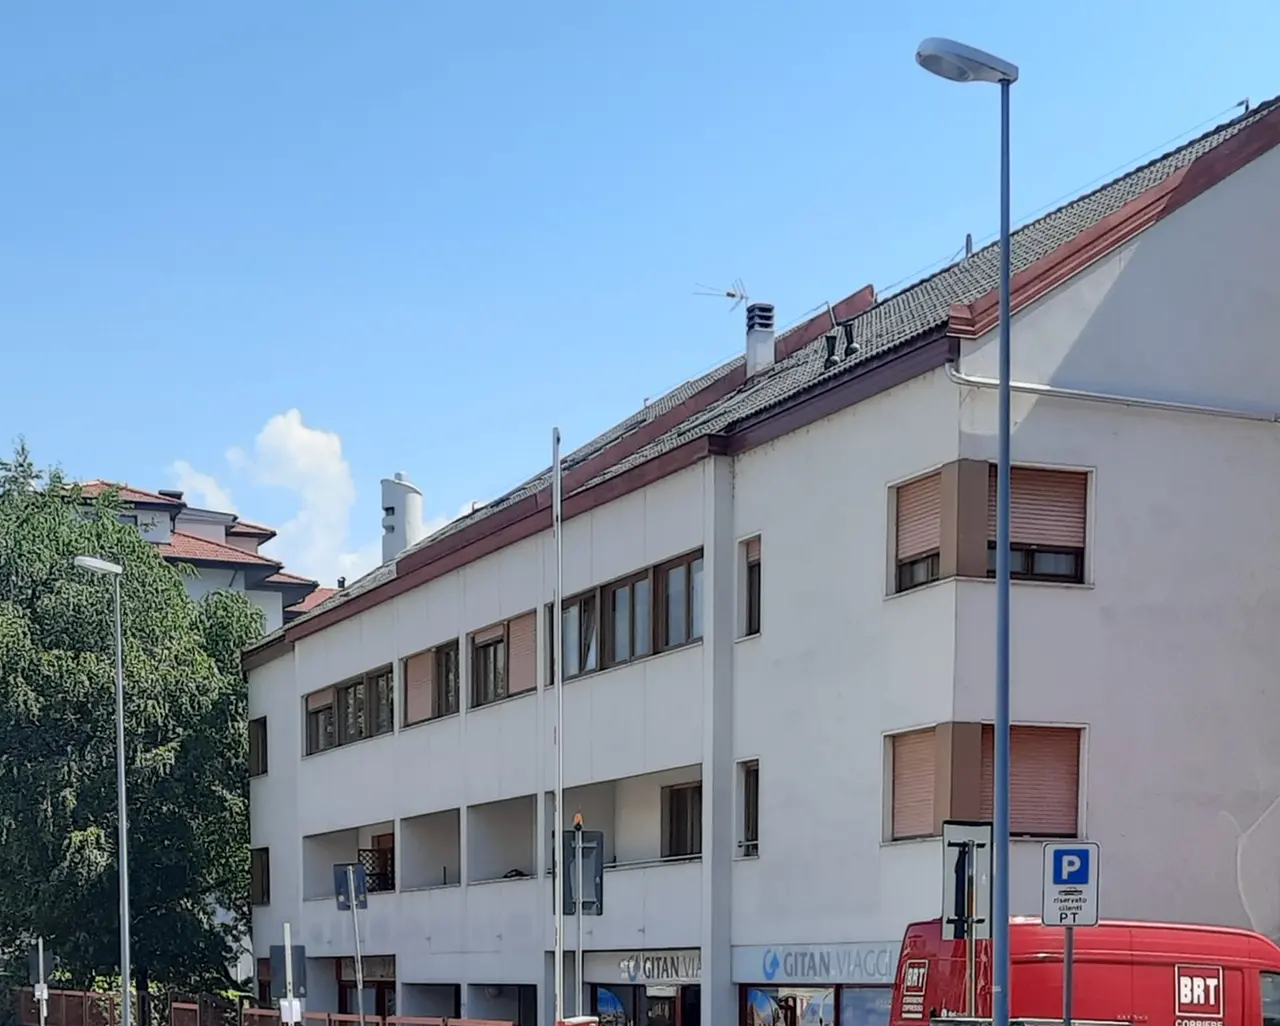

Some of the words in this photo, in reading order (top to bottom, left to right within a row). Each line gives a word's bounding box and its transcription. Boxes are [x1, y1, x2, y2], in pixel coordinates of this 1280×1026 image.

[1061, 854, 1082, 880] P
[1053, 896, 1088, 904] riservato
[643, 956, 679, 979] GITAN
[783, 951, 831, 978] GITAN
[836, 949, 892, 978] VIAGGI
[907, 967, 925, 987] BRT
[1179, 975, 1219, 1006] BRT
